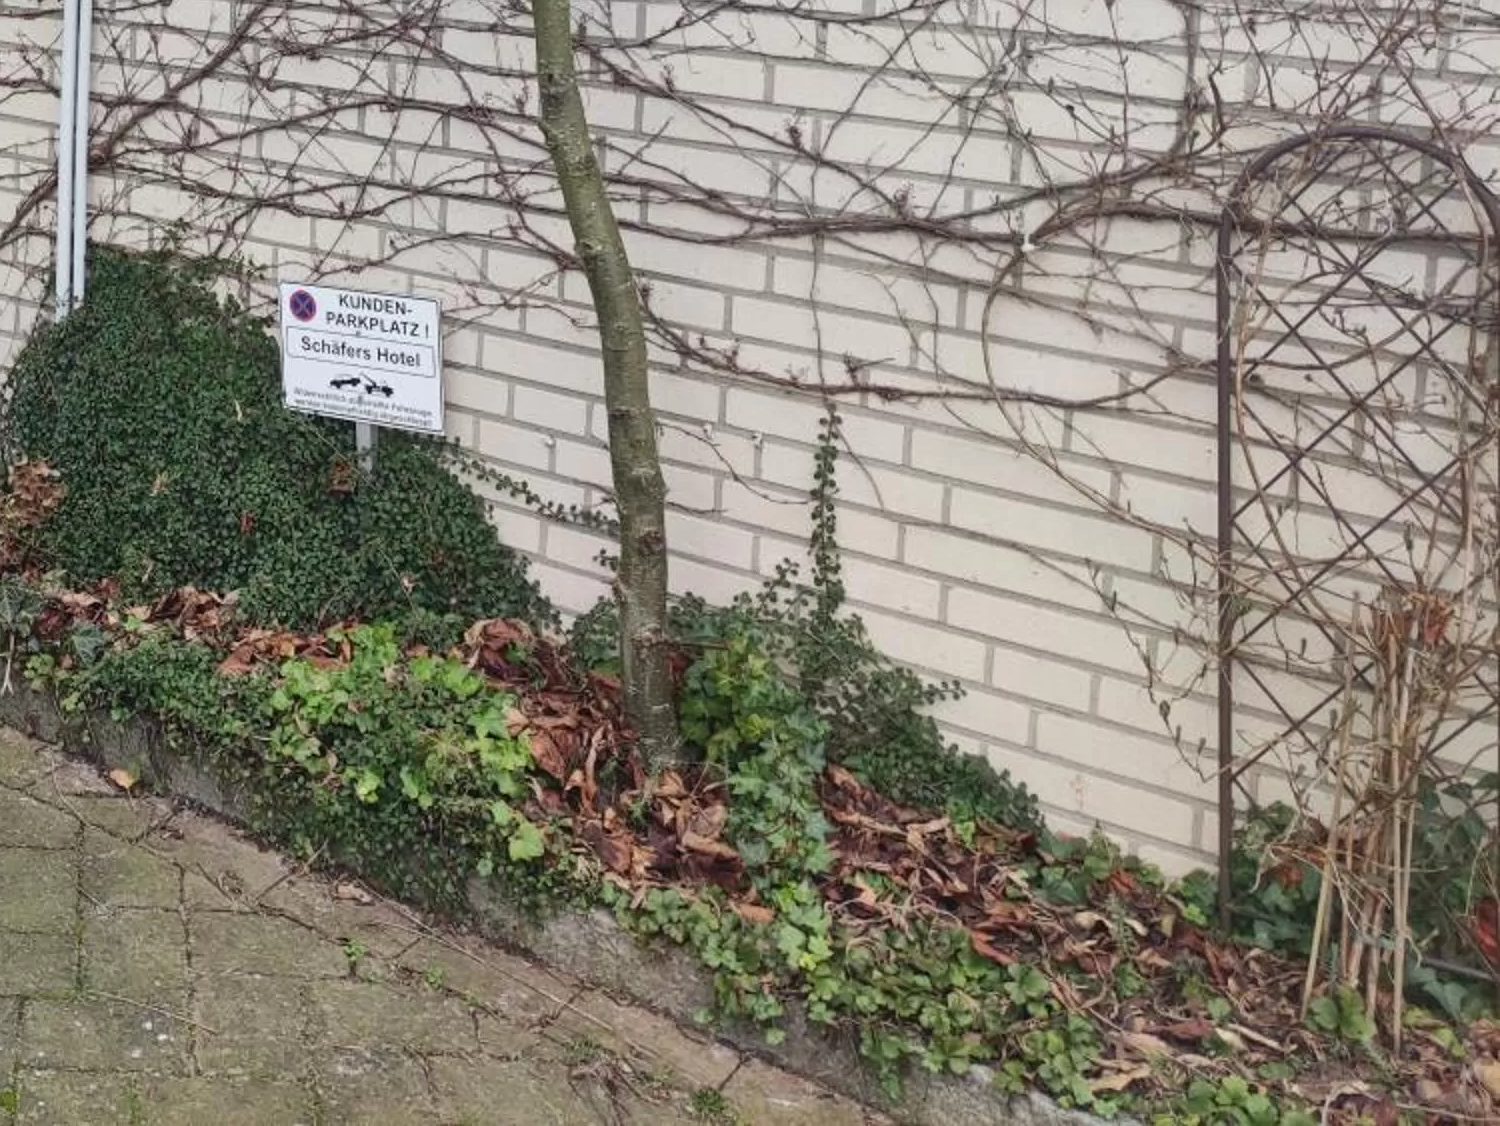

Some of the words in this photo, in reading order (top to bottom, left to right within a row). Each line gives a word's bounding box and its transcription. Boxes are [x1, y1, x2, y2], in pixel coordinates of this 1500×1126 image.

[339, 294, 413, 316] KUNDEN-
[326, 311, 420, 337] PARKPLATZ
[301, 335, 371, 361] Schäfers
[377, 347, 421, 367] Hotel
